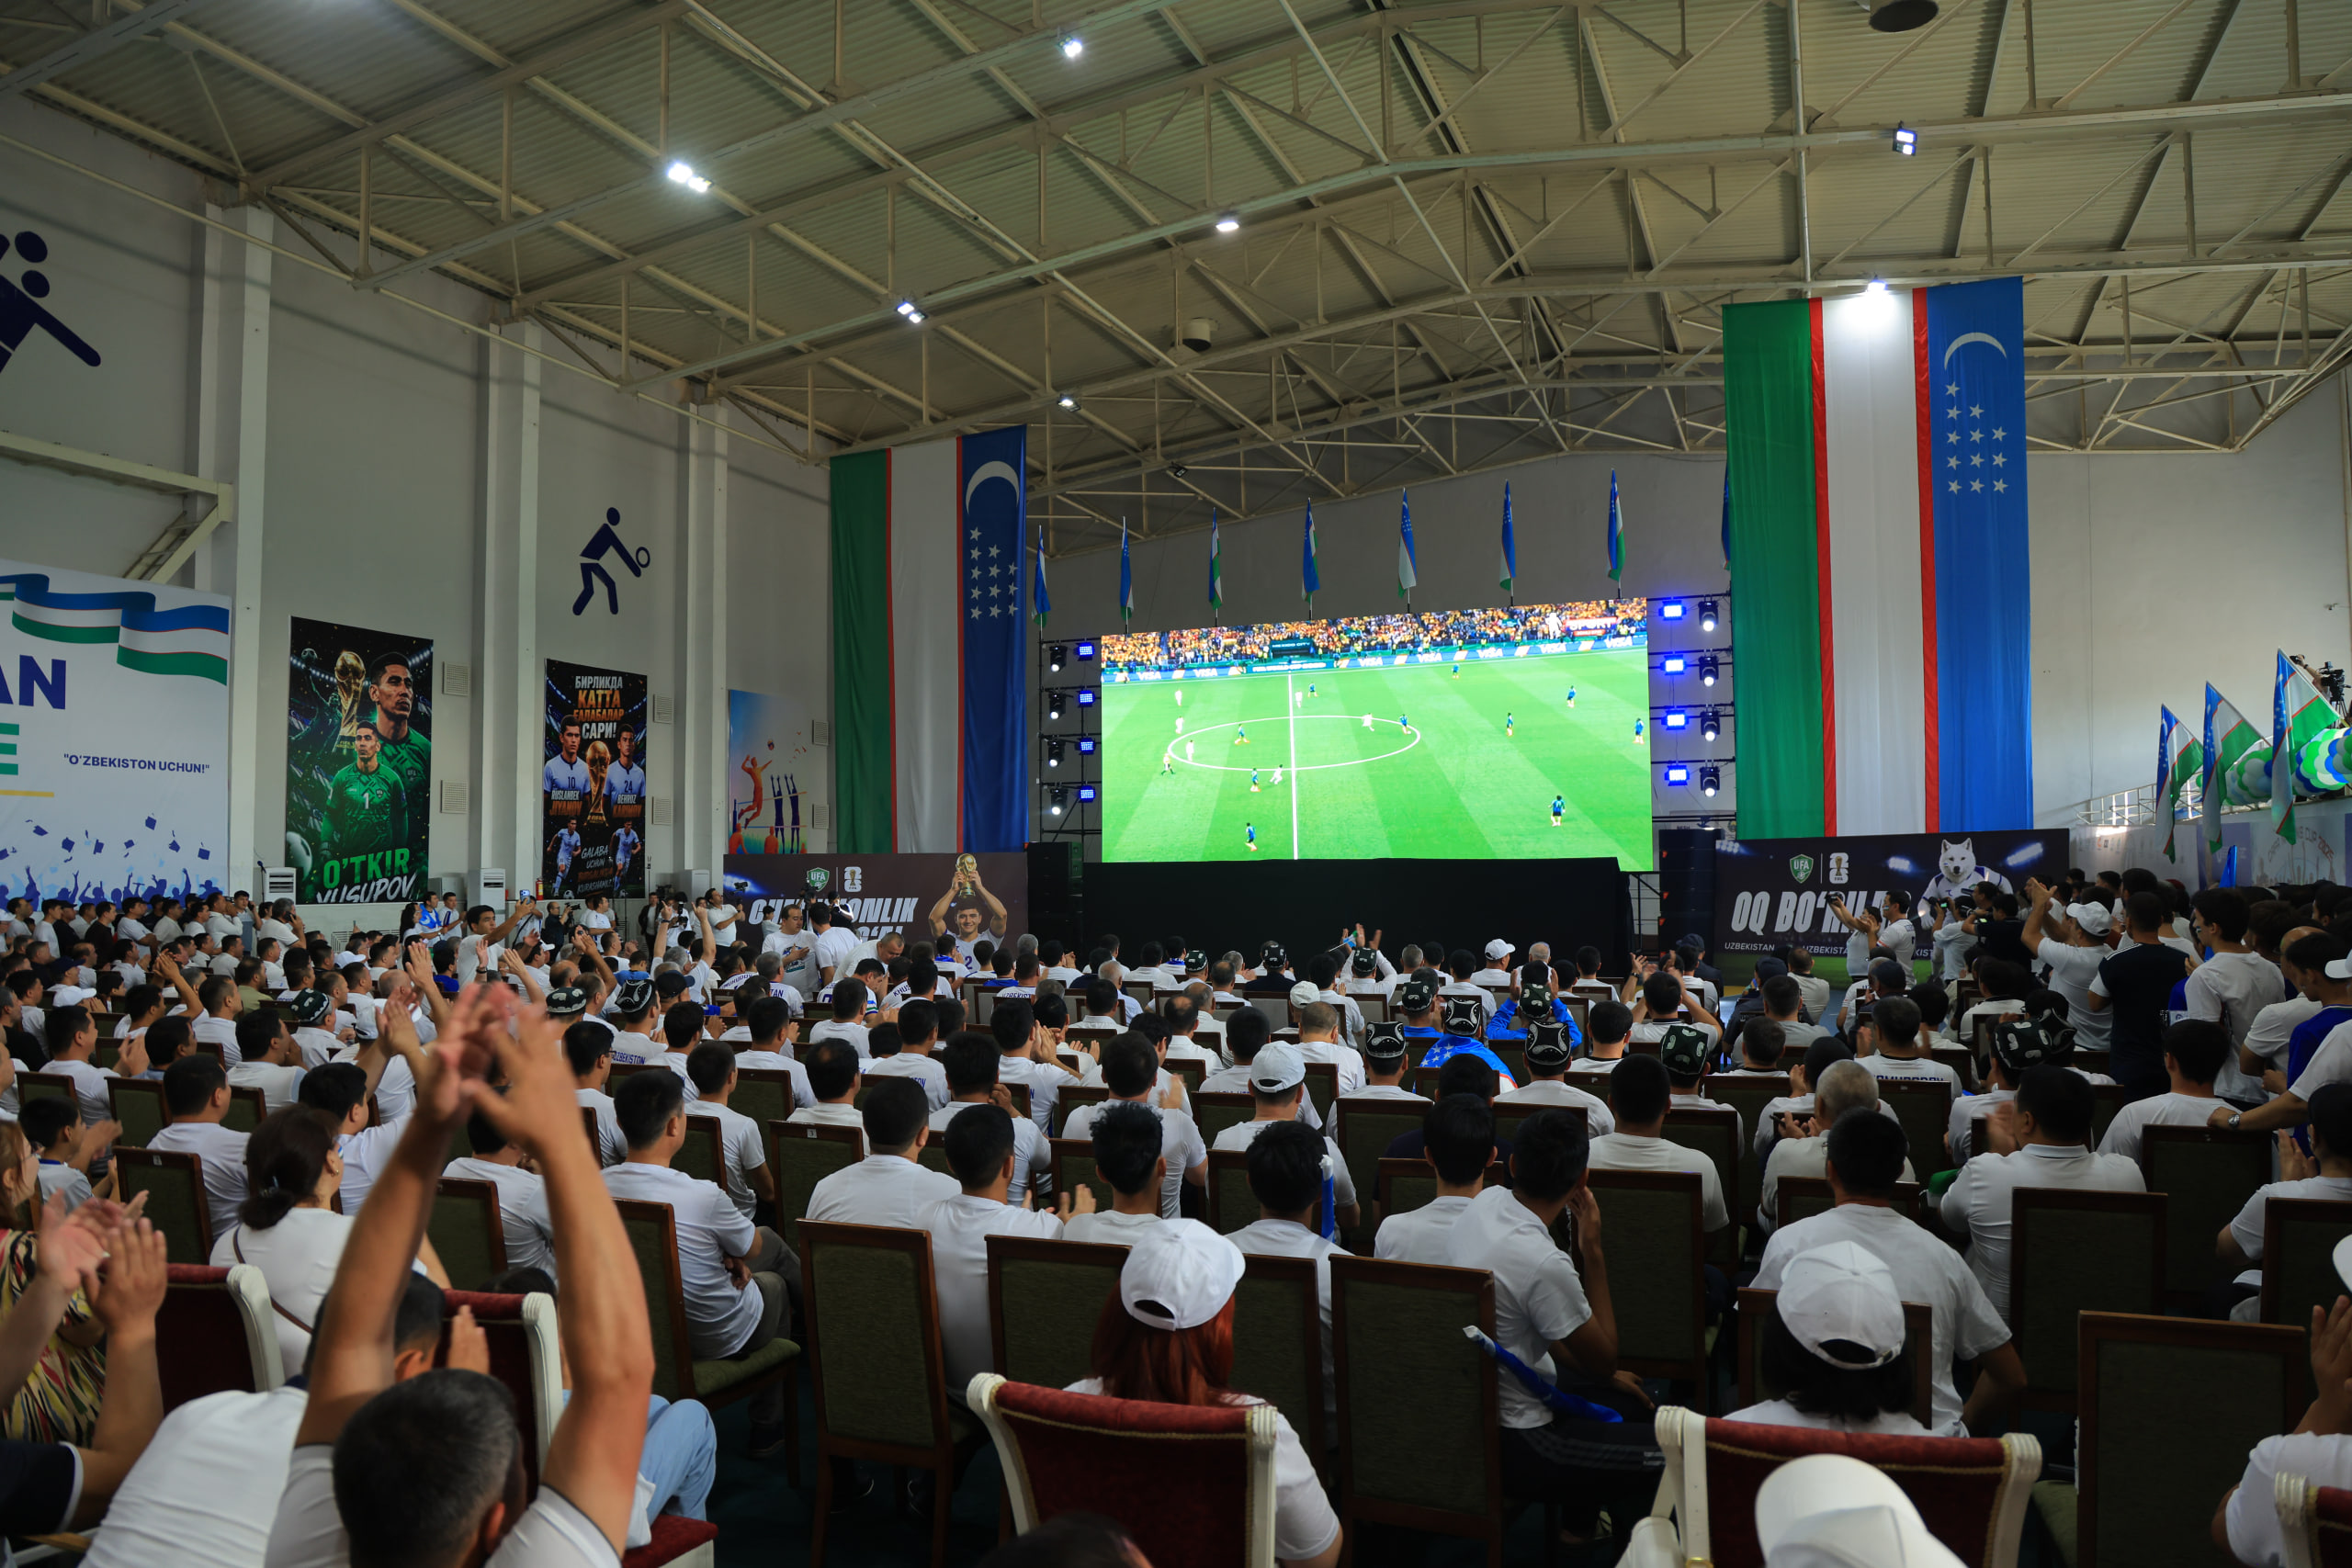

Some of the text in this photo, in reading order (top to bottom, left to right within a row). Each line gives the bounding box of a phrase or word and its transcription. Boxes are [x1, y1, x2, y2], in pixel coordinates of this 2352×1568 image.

[1604, 636, 1633, 648] VISA
[1476, 648, 1503, 658] VISA
[1539, 643, 1566, 653] VISA
[1358, 657, 1383, 667] VISA
[1417, 652, 1442, 662] VISA
[1136, 671, 1161, 681] VISA
[1193, 668, 1218, 678] VISA
[0, 654, 66, 710] N
[575, 676, 623, 690] БИРЛИКДА
[578, 690, 621, 709] КАТТА
[582, 722, 616, 739] САРИ!
[568, 776, 576, 789] 10
[624, 780, 633, 794] 24
[363, 793, 369, 810] 1
[1793, 860, 1810, 871] UFA
[810, 872, 826, 881] UFA
[1731, 891, 1770, 935] OQ
[1724, 942, 1775, 952] UZBEKISTAN
[1803, 945, 1849, 955] UZBEKISTA
[965, 956, 972, 969] 2
